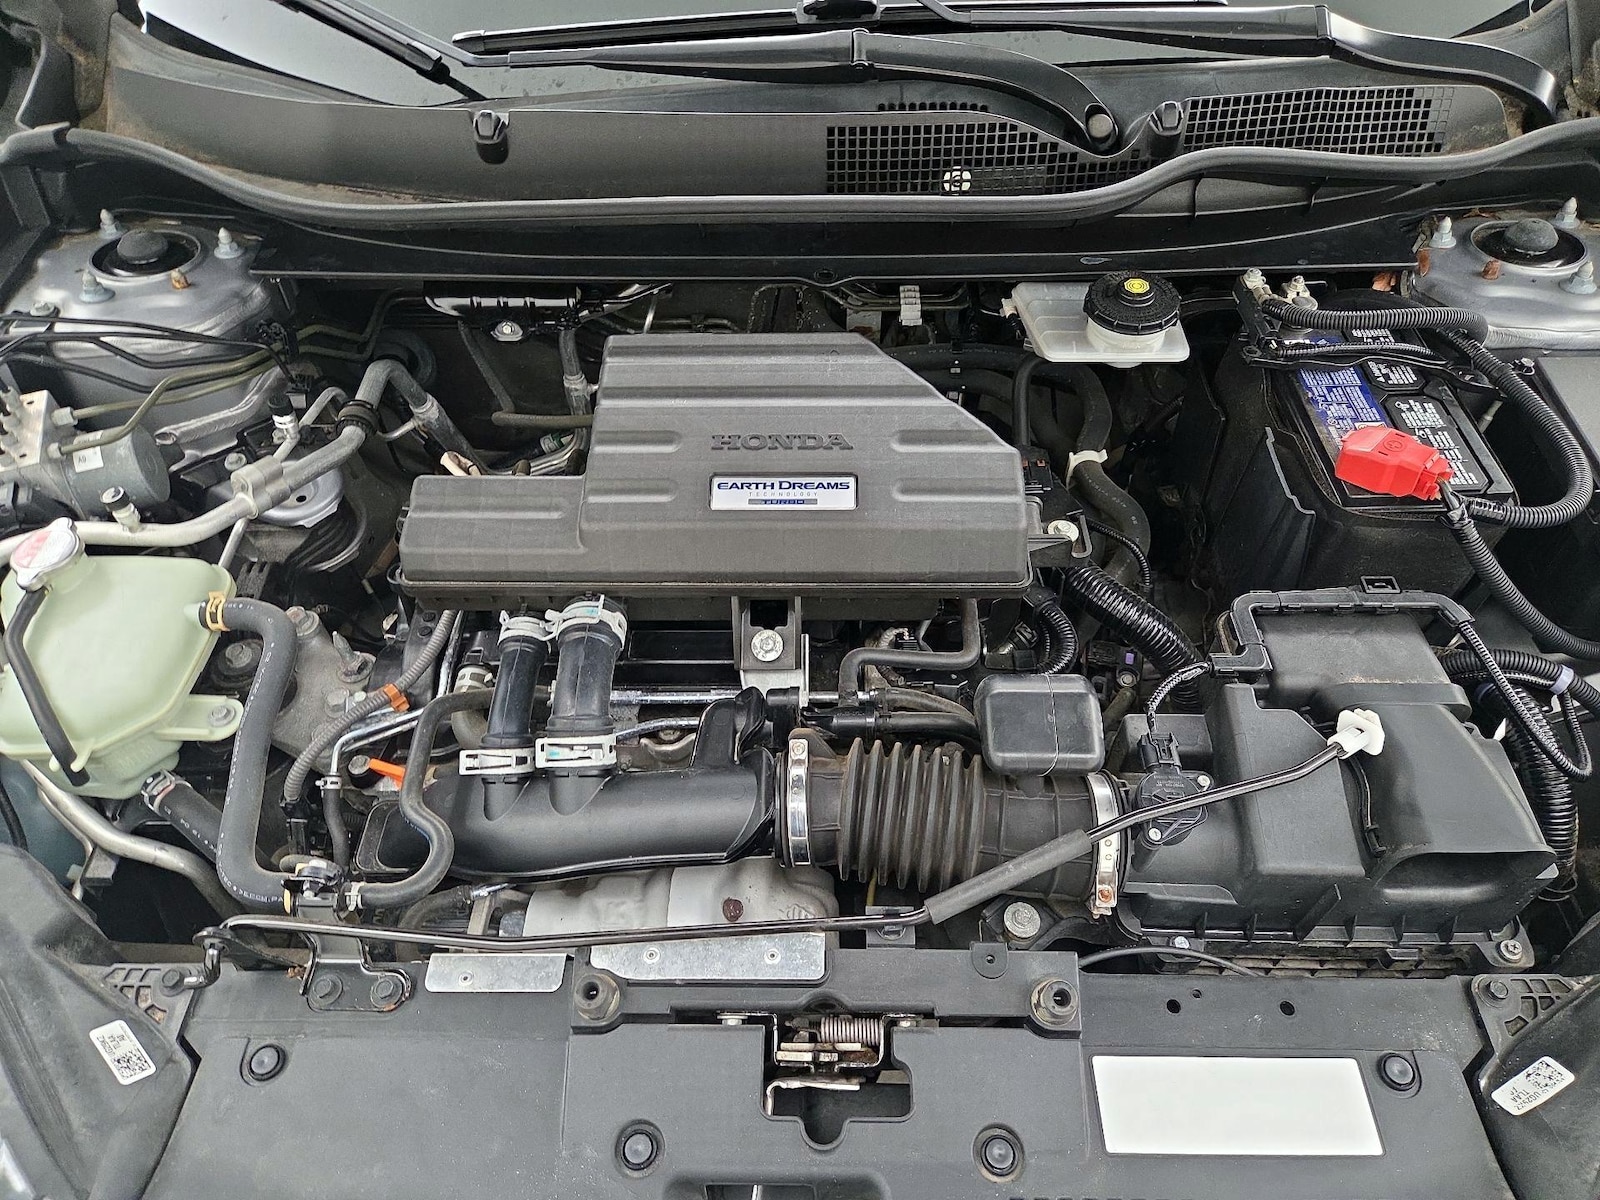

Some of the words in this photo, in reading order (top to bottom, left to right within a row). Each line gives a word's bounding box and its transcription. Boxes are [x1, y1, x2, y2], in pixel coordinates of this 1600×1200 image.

[711, 433, 854, 451] HONDA
[717, 482, 775, 490] EARTH
[778, 480, 850, 490] DREAMS
